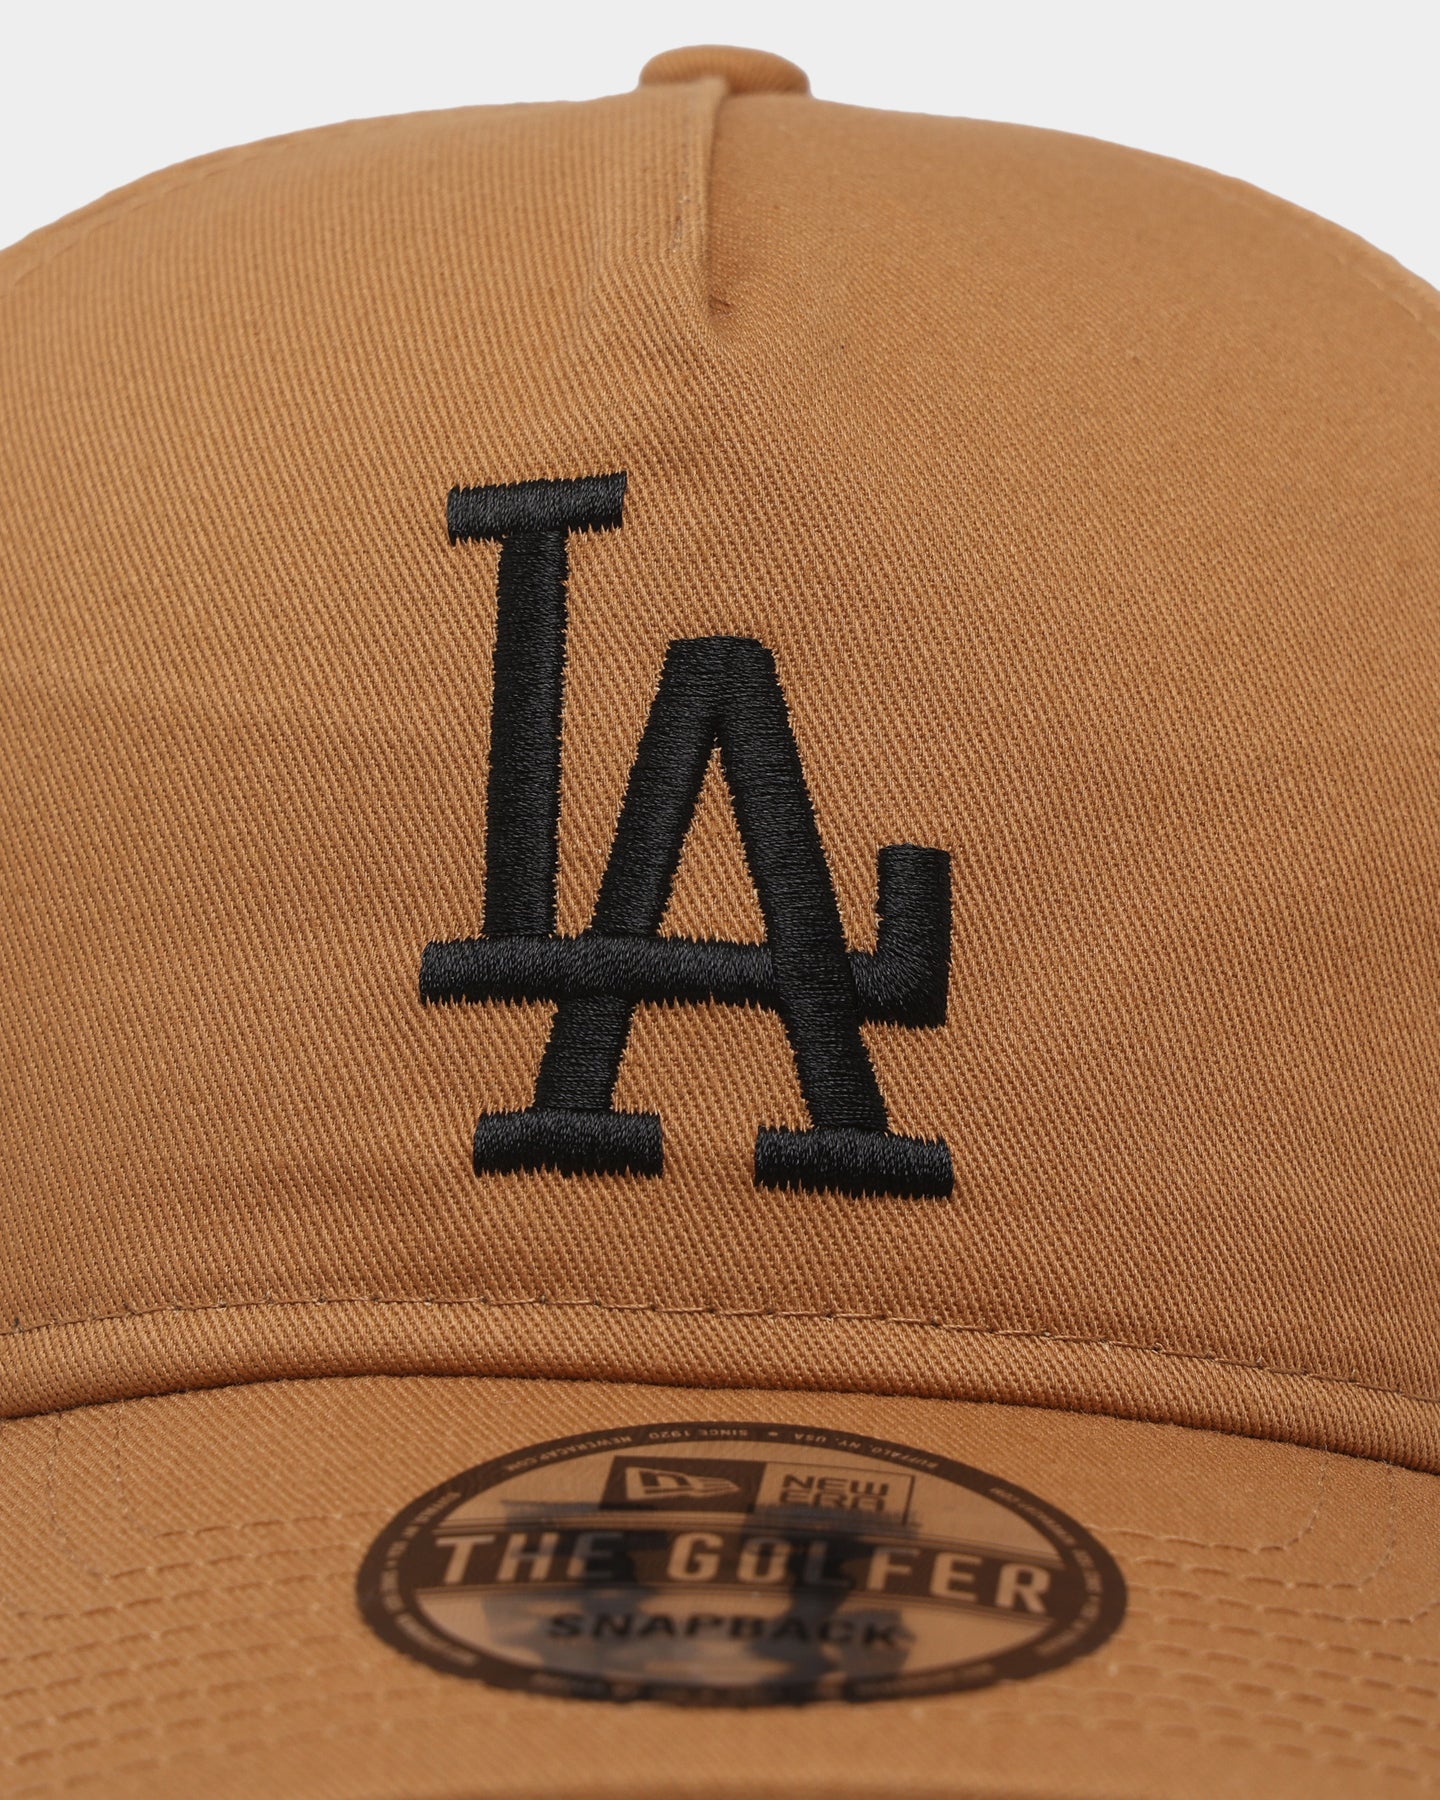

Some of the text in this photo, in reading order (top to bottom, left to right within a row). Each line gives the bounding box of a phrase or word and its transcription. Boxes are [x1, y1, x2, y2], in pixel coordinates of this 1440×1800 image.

[420, 470, 955, 1198] LA
[648, 1430, 690, 1440] 1920
[702, 1429, 748, 1437] SINCE
[794, 1432, 827, 1443] USA
[782, 1474, 889, 1497] NEW
[780, 1488, 887, 1512] ERA
[434, 1532, 623, 1585] THE
[666, 1531, 1050, 1614] GOLFER
[548, 1612, 899, 1648] SNAPBACK
